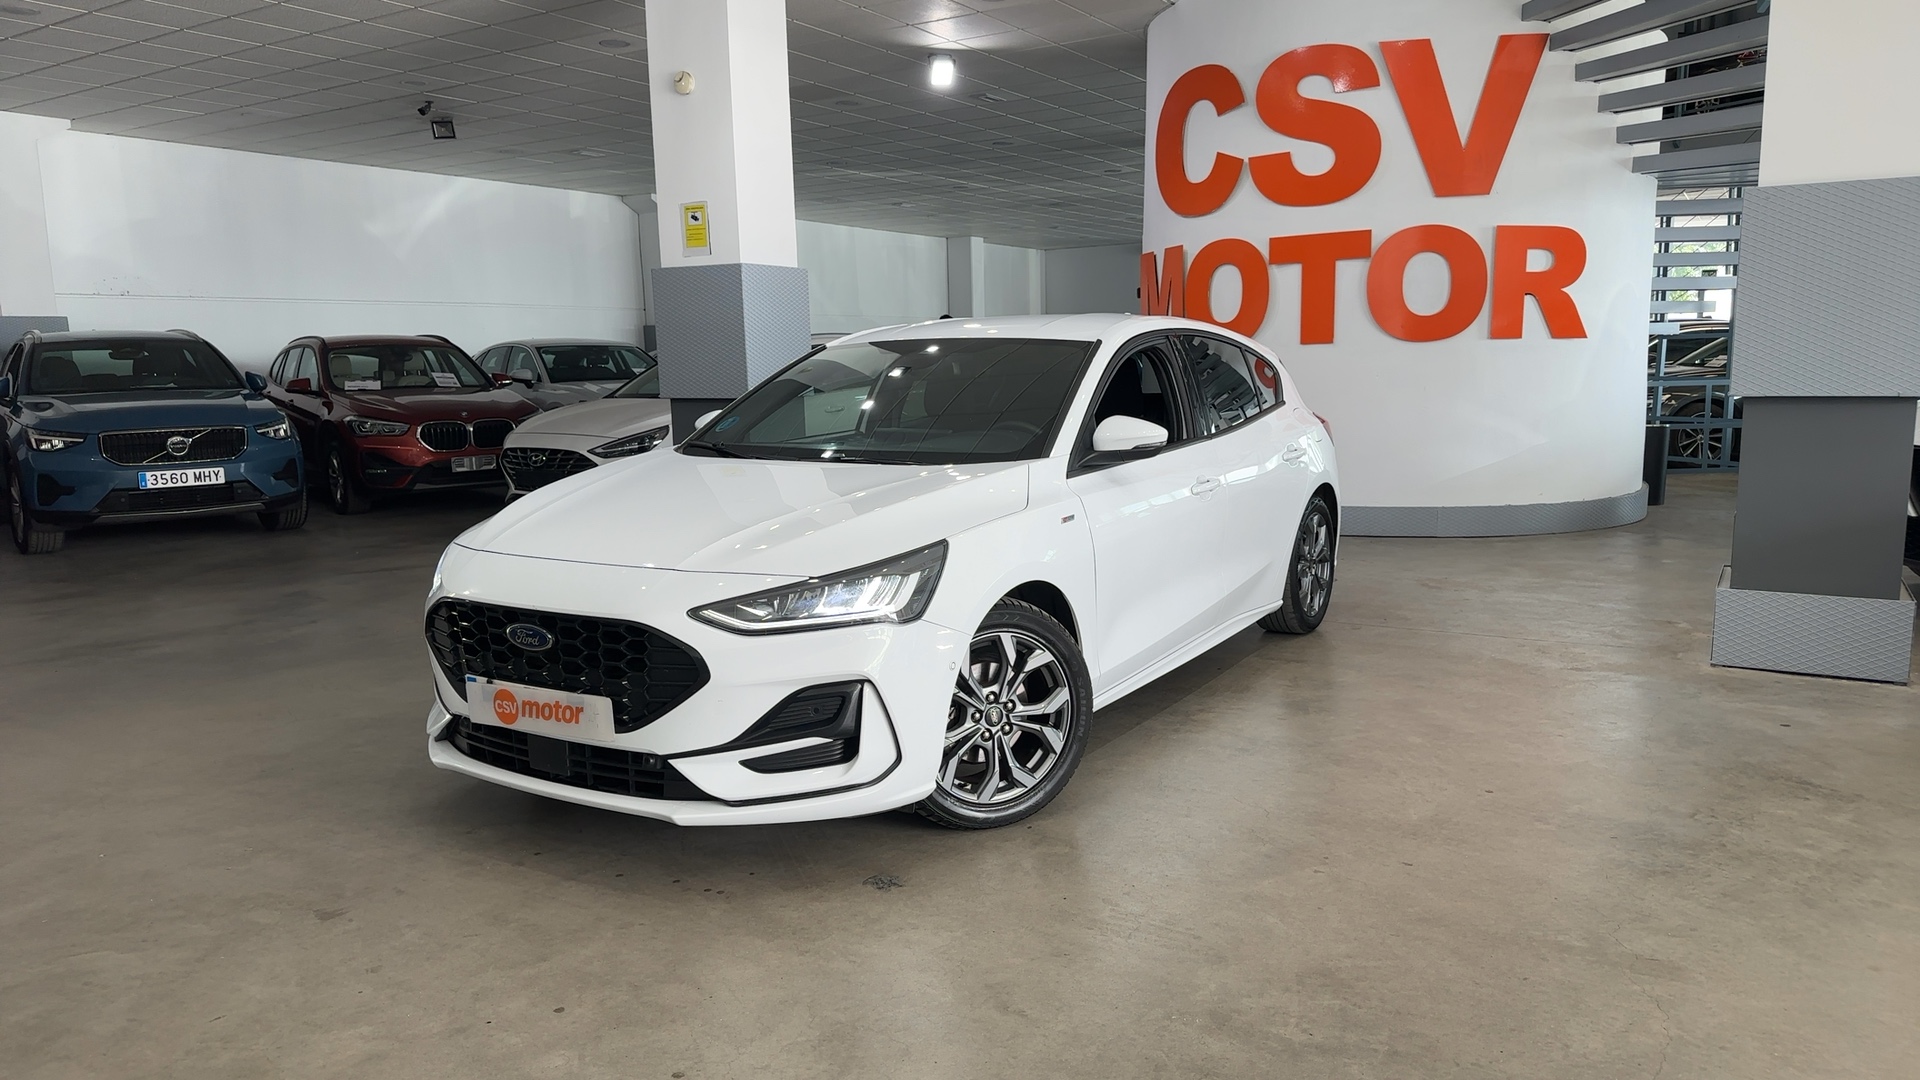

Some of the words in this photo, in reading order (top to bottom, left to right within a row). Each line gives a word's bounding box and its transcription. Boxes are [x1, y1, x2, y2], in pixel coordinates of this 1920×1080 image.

[1155, 33, 1550, 218] CSV
[1140, 224, 1589, 345] MOTOR
[150, 472, 189, 486] 3560
[193, 469, 221, 483] MHY
[515, 629, 540, 646] Ford
[495, 700, 517, 714] CSV
[521, 699, 584, 724] motor
